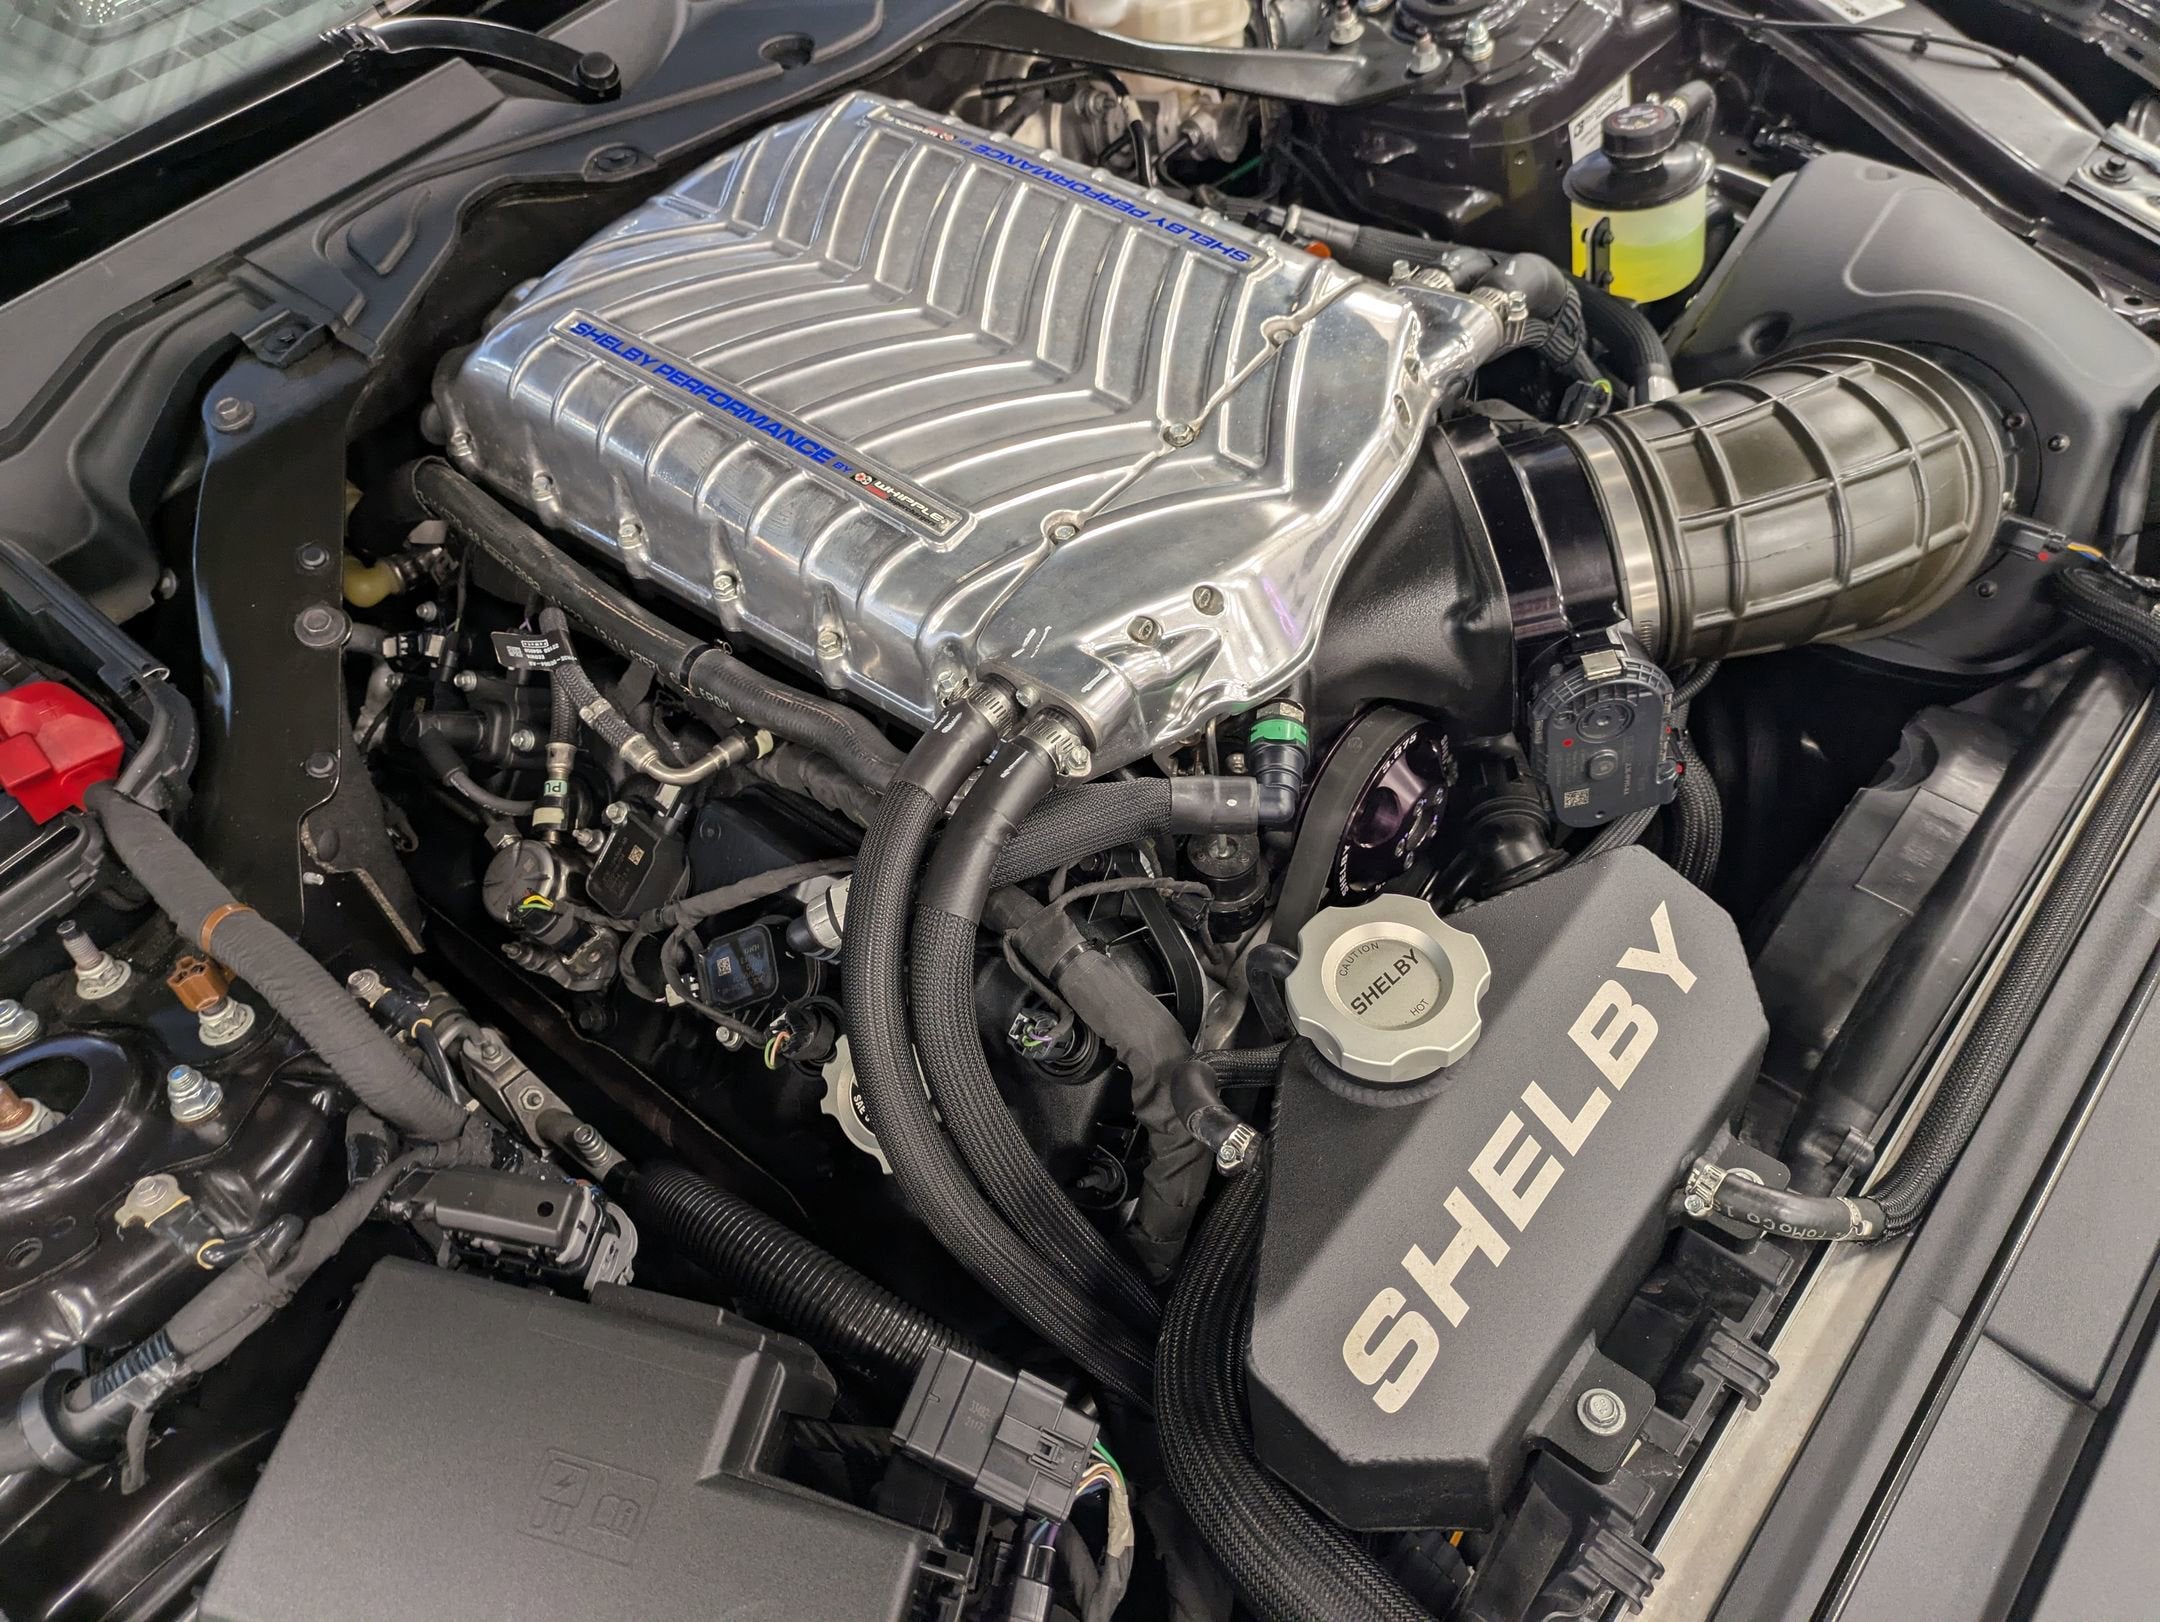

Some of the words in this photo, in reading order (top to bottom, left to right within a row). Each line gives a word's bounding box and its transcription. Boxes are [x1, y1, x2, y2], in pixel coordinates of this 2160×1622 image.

[971, 144, 1150, 219] PERFORMANCE
[1147, 217, 1252, 263] SHELBY
[570, 321, 658, 367] SHELBY
[654, 363, 837, 465] PERFORMANCE
[832, 461, 853, 473] BY
[874, 480, 945, 521] WHIPPLE
[1338, 845, 1350, 897] SHELBY
[1339, 941, 1379, 977] CAUTION
[1350, 948, 1419, 1015] SHELBY
[1409, 998, 1430, 1016] HOT
[853, 1094, 866, 1115] SAE
[1343, 900, 1698, 1414] SHELBY
